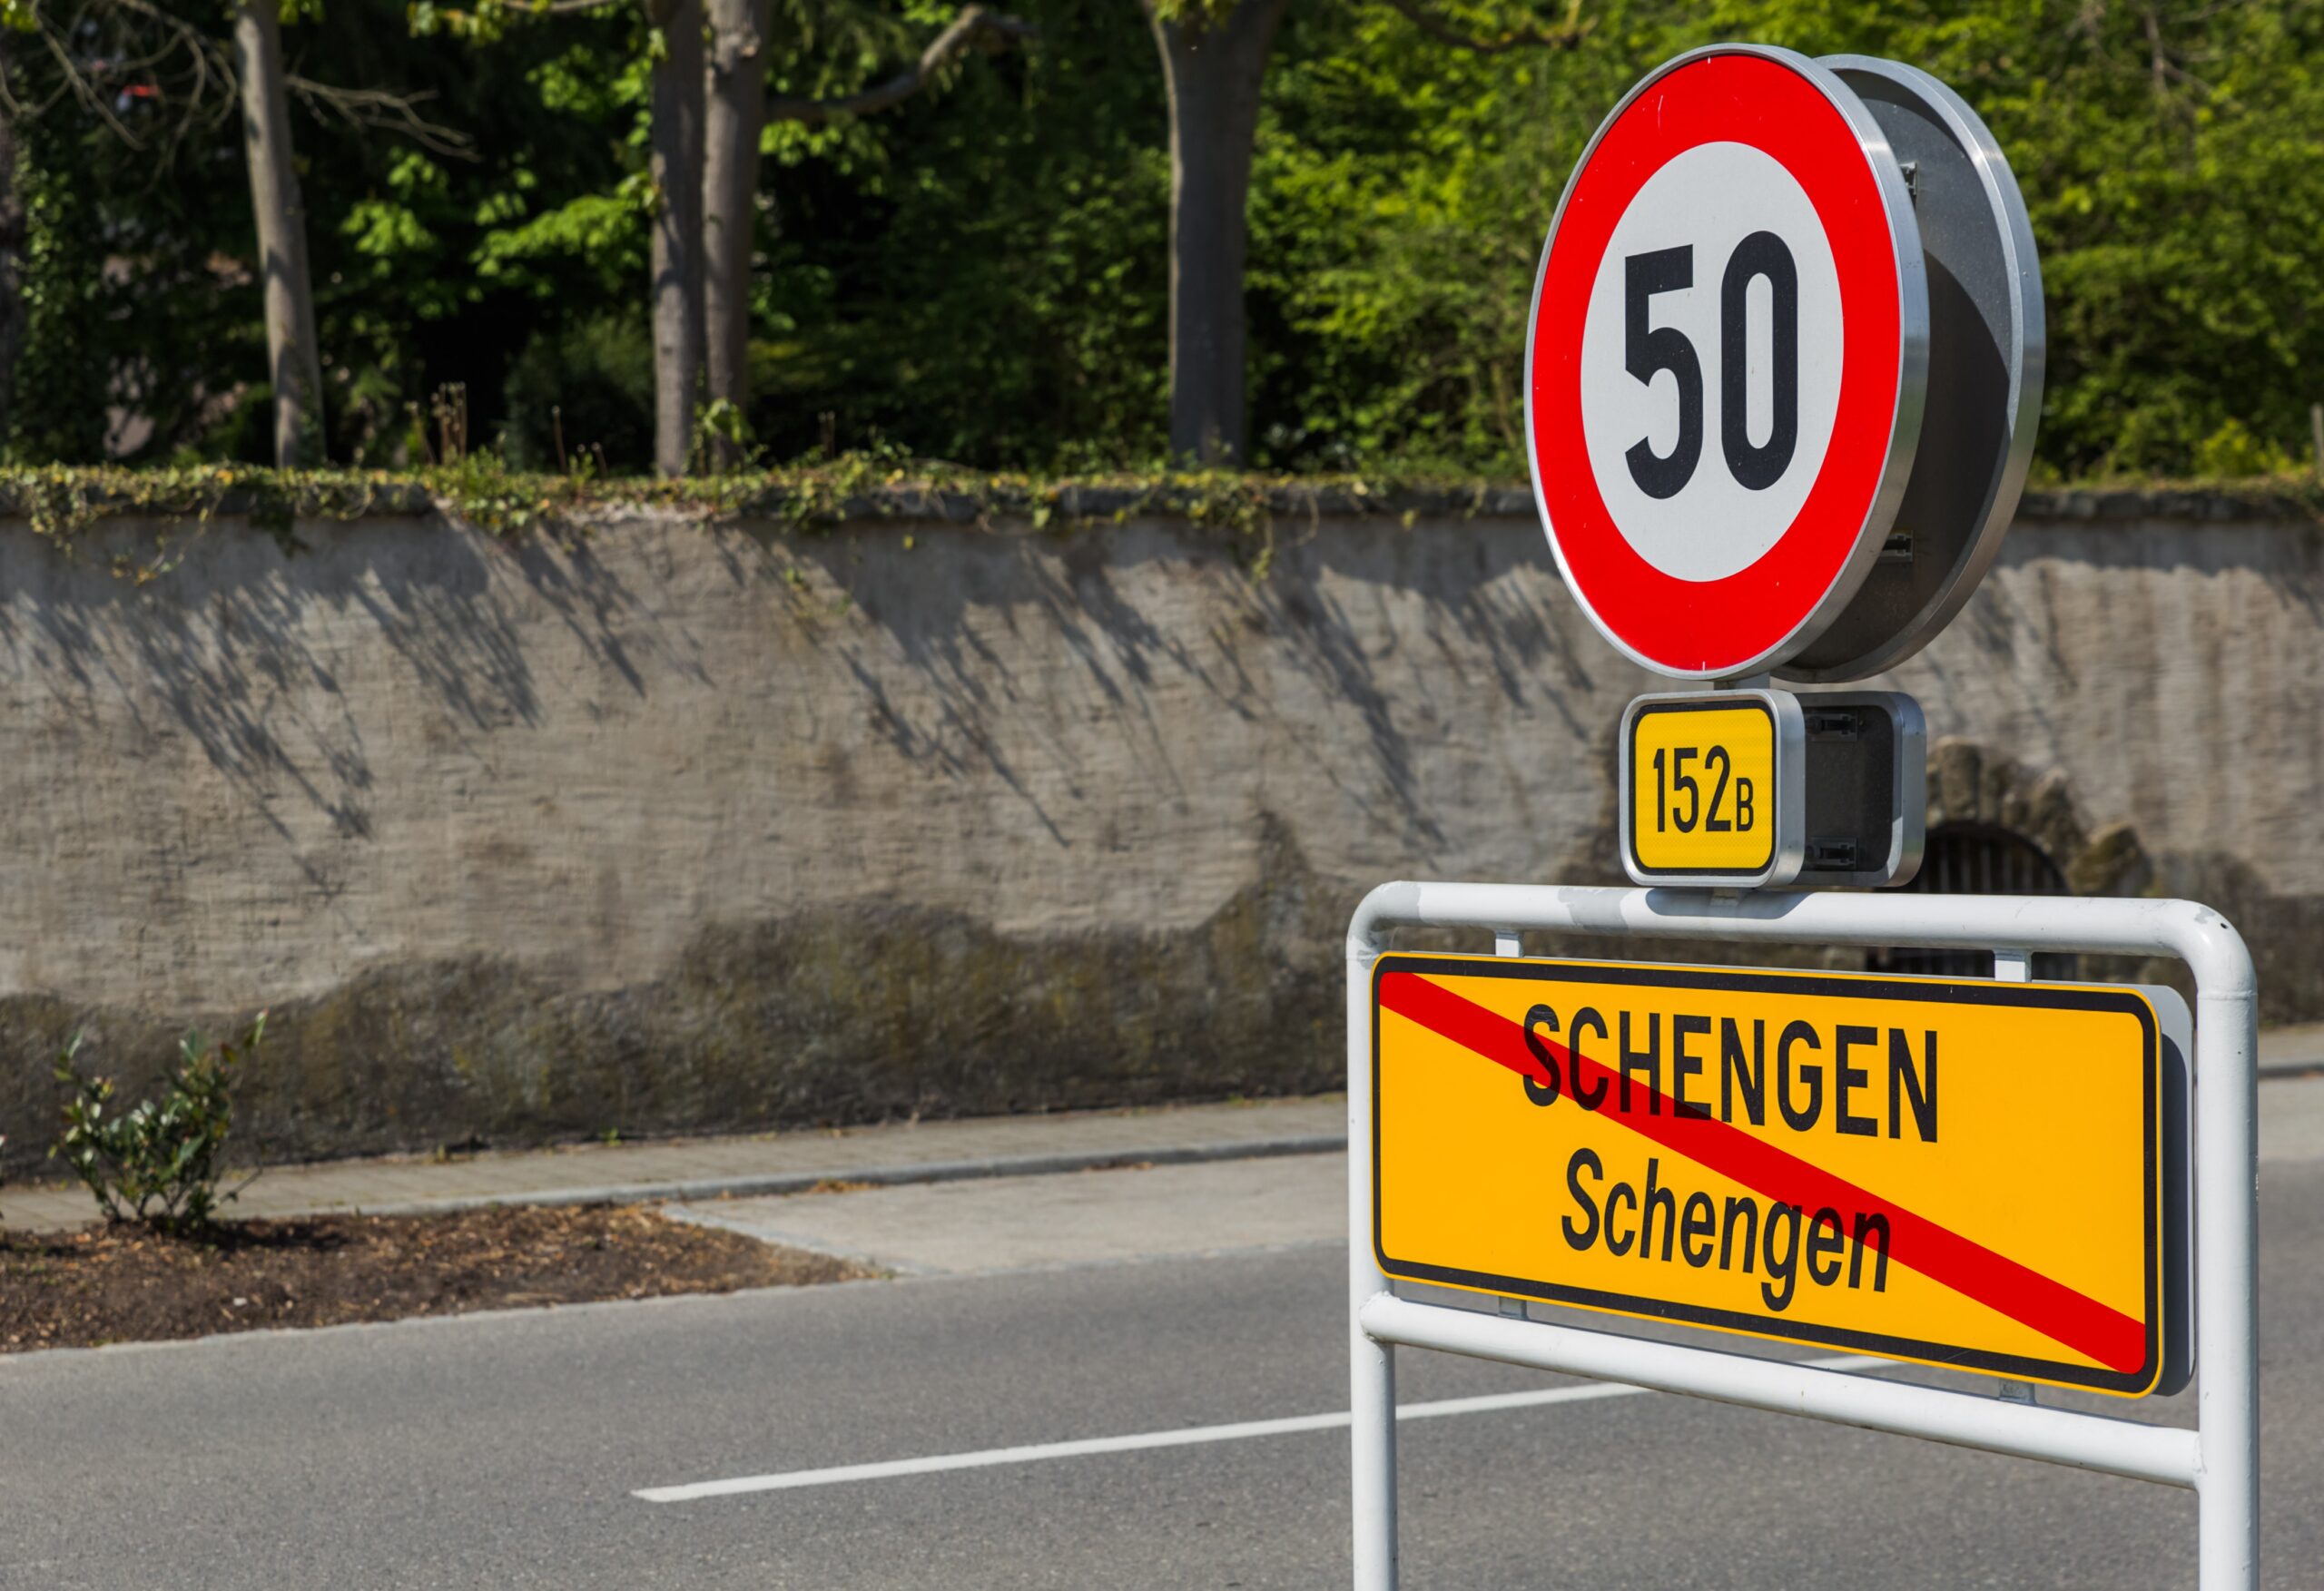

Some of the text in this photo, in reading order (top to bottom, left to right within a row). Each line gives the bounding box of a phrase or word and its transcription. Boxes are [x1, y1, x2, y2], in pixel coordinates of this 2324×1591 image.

[1625, 231, 1798, 499] 50
[1653, 745, 1755, 833] 152B
[1522, 1003, 1938, 1144] SCHENGEN
[1561, 1146, 1892, 1312] Schengen
